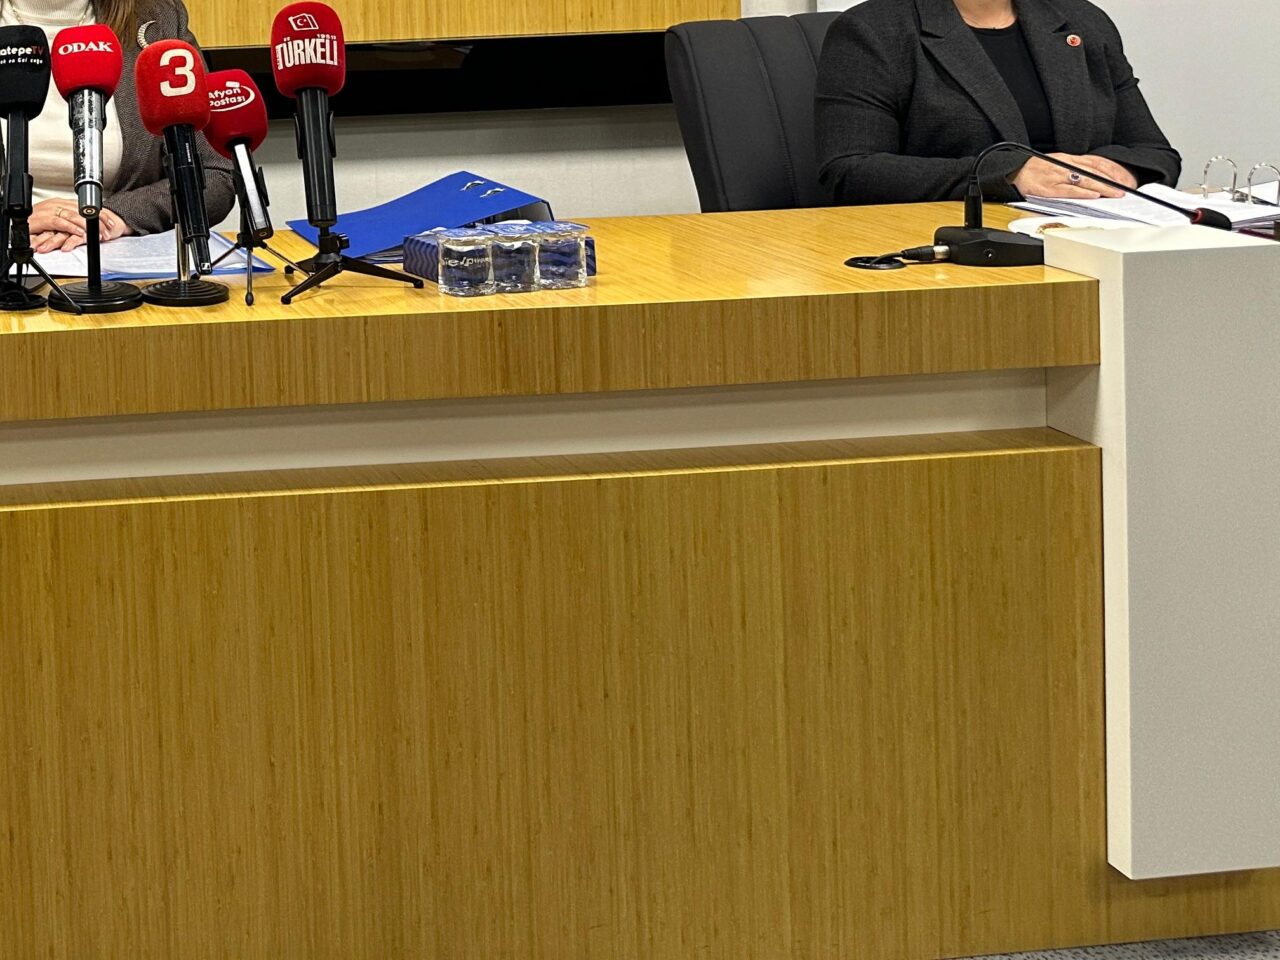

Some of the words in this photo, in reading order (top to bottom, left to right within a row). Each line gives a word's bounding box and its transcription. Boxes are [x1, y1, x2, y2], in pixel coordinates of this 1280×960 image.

[58, 41, 114, 55] ODAK
[275, 35, 338, 70] TÜRKELİ
[159, 48, 196, 97] 3
